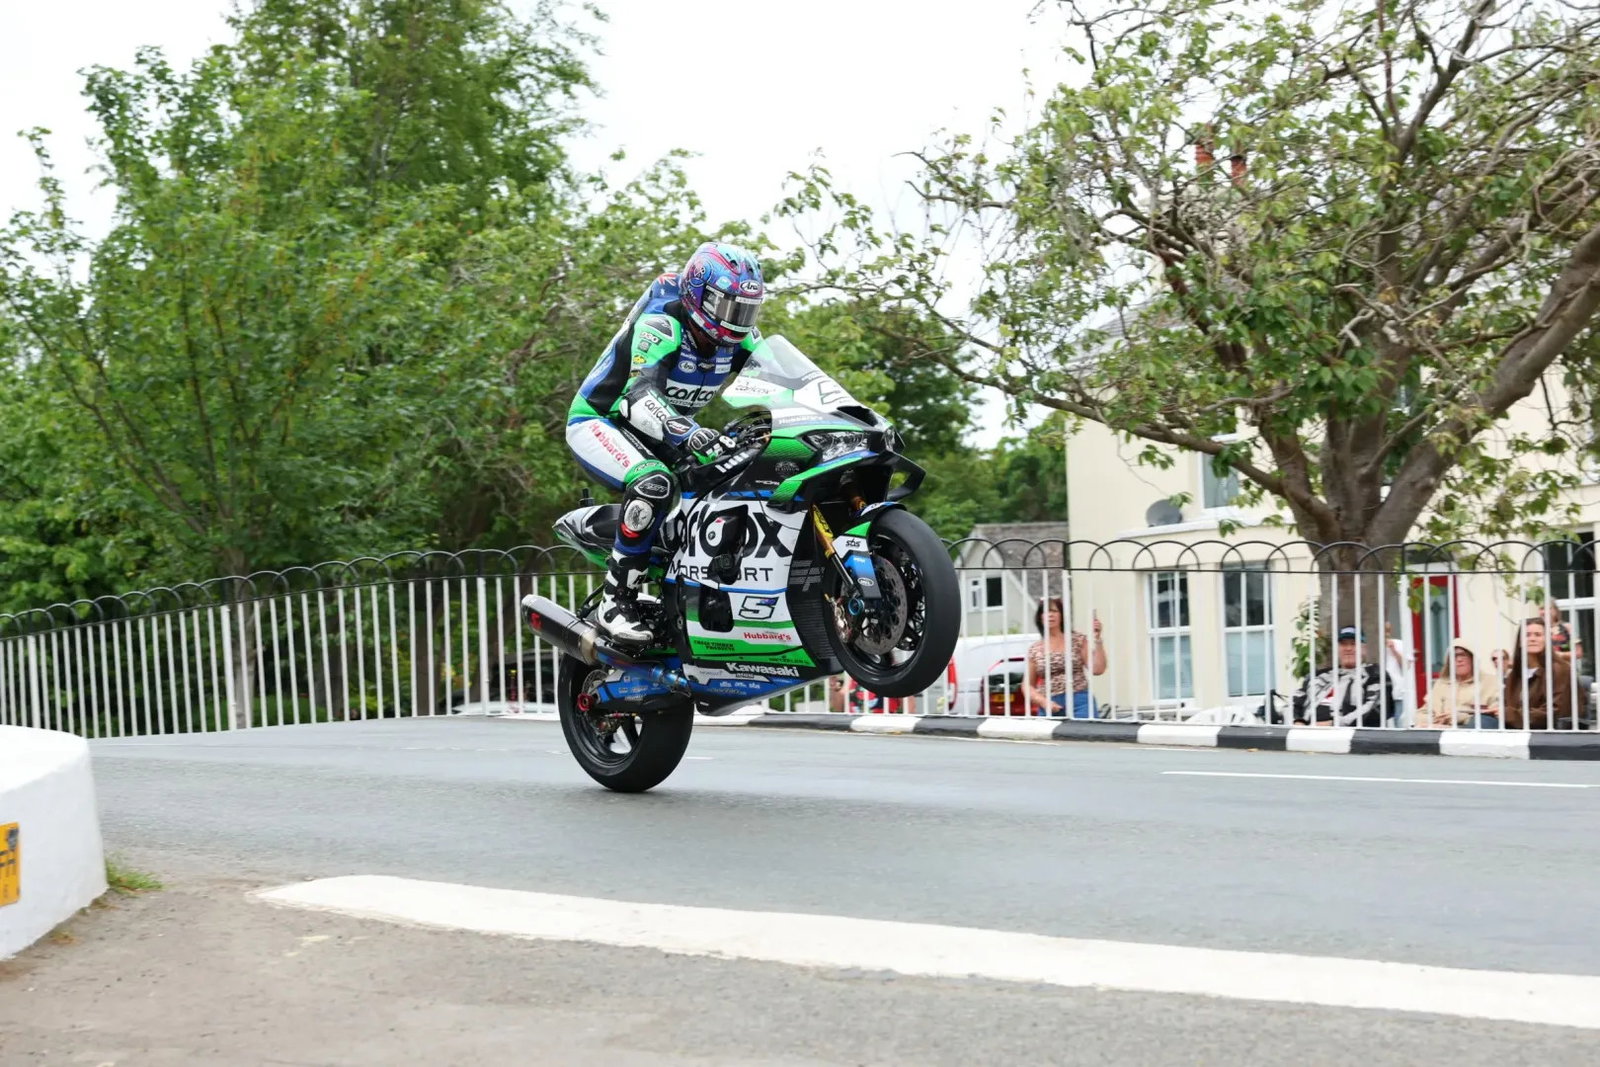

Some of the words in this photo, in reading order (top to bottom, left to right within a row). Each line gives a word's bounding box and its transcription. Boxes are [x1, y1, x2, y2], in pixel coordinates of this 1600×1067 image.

[665, 386, 716, 402] carlco
[644, 399, 667, 421] carlco
[589, 421, 631, 469] Hubbard's
[845, 538, 861, 547] sbs
[738, 595, 779, 620] 5
[743, 632, 792, 641] Hubbard's
[726, 662, 800, 677] Kawasaki
